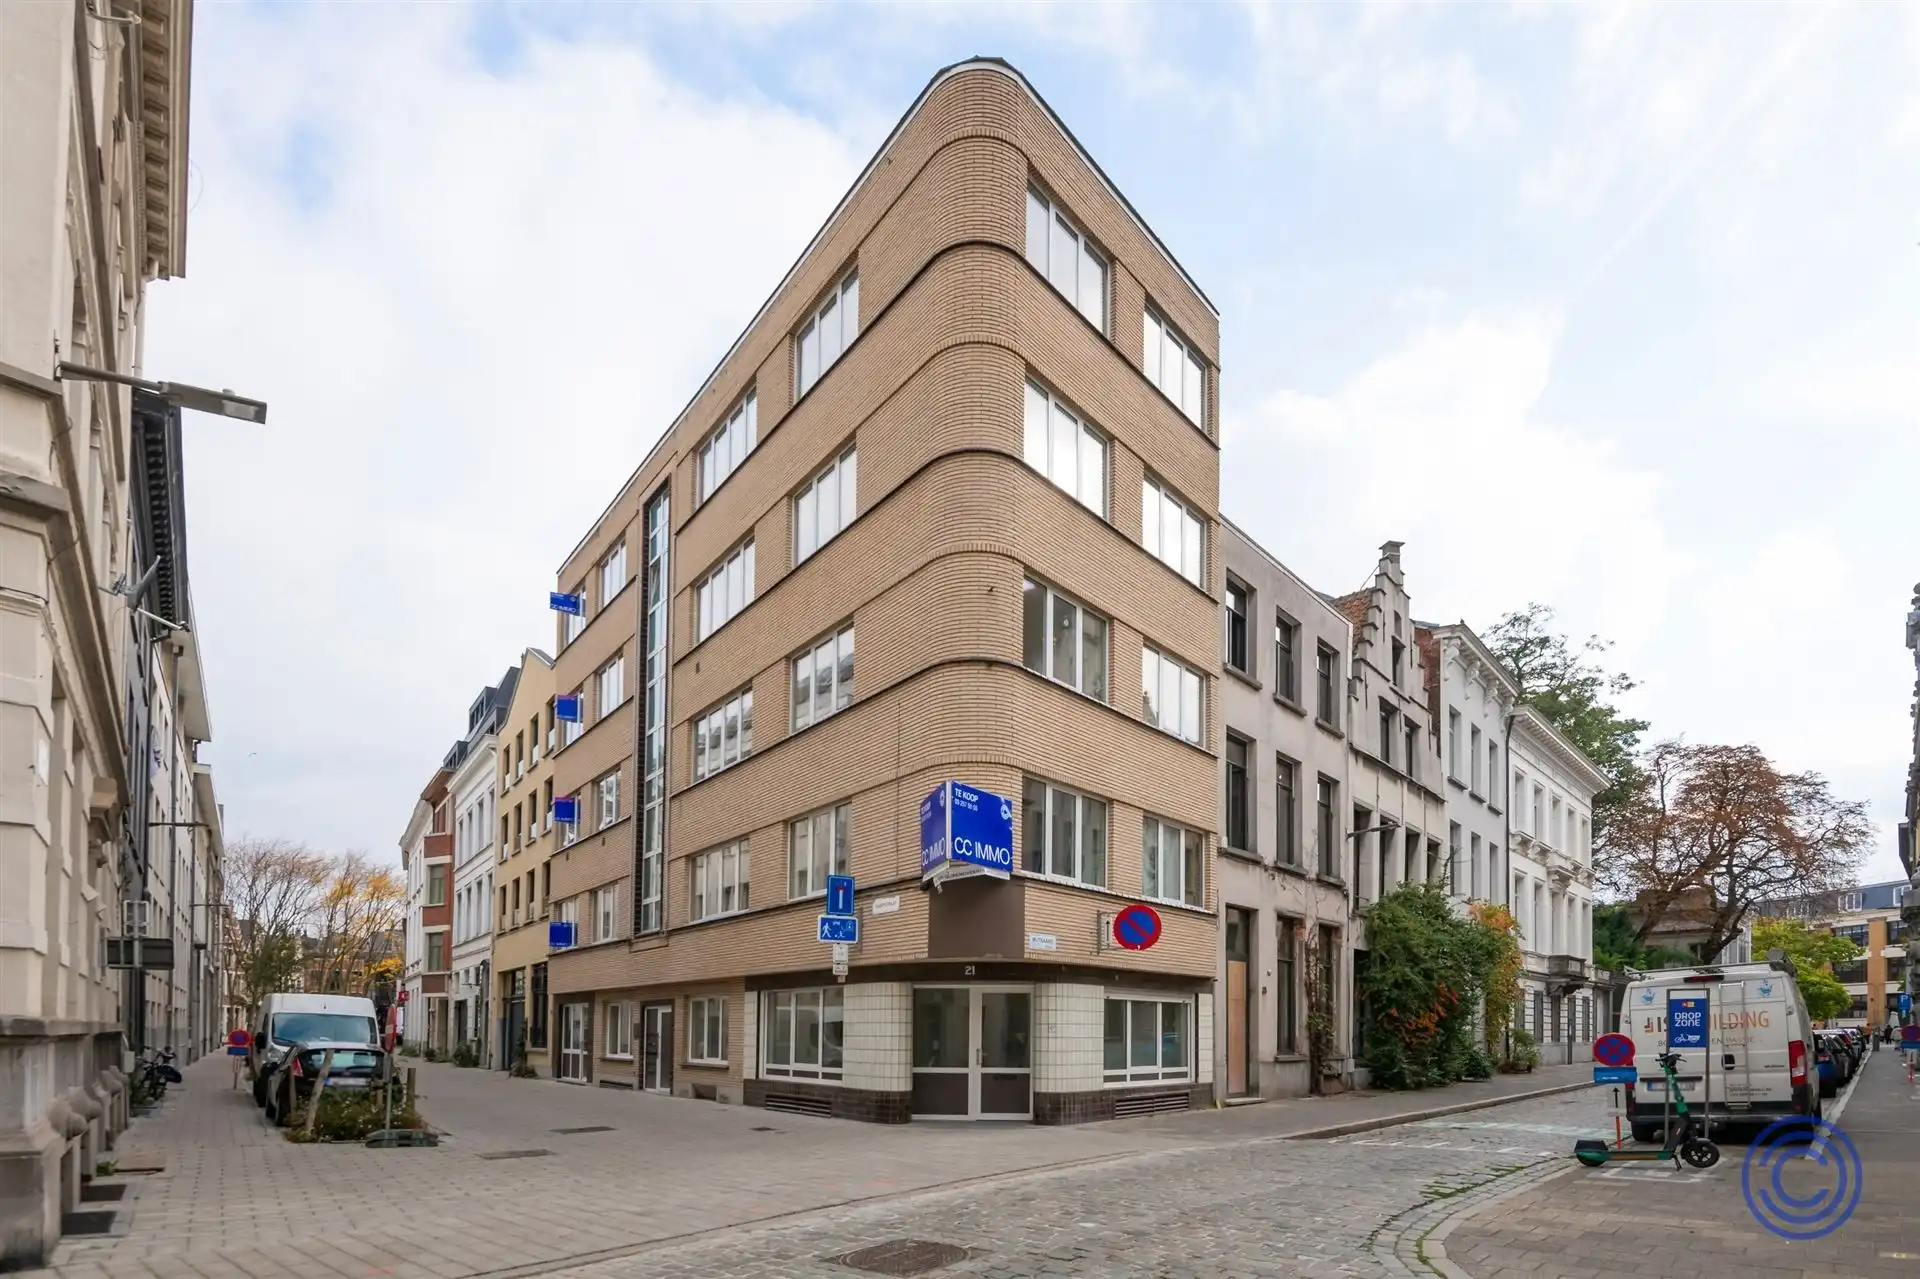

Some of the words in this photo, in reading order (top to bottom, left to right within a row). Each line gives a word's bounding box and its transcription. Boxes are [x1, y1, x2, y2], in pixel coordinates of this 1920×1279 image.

[954, 787, 962, 798] TE
[962, 790, 979, 803] KOOP
[954, 837, 972, 856] CC
[975, 841, 1010, 865] IMMO
[964, 965, 976, 976] 21
[1674, 1012, 1702, 1020] DROP
[1708, 1010, 1770, 1030] ILDING
[1674, 1019, 1701, 1027] ZONE
